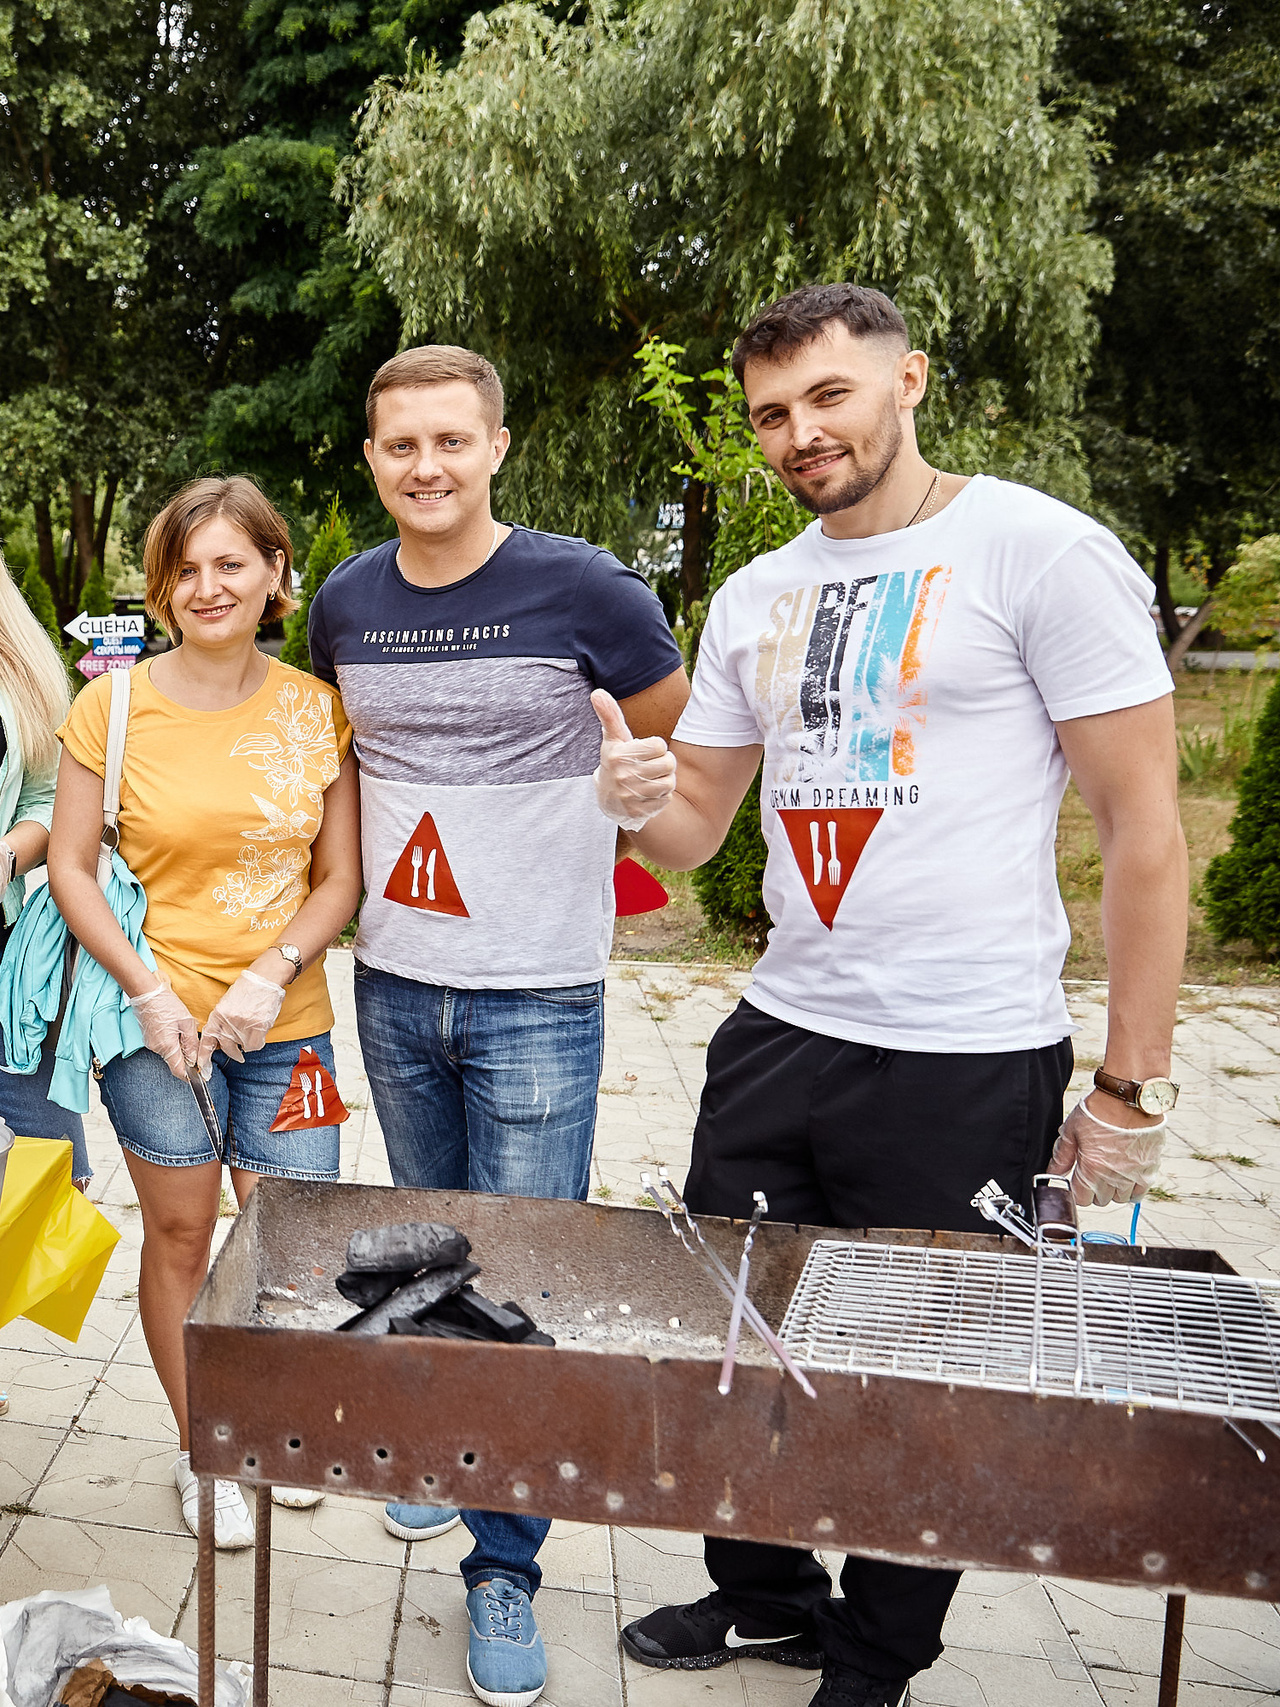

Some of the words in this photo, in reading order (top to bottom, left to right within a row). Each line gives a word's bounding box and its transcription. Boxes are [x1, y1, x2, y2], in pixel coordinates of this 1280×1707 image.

[79, 620, 139, 635] СЦЕНА
[363, 628, 455, 644] FASCINATING
[463, 624, 511, 641] FACTS
[416, 645, 439, 653] PEOPLE
[462, 643, 478, 651] LIFE
[79, 659, 105, 672] FREE
[106, 659, 136, 671] ZONE
[813, 784, 920, 808] DREAMING
[245, 914, 282, 932] Brave
